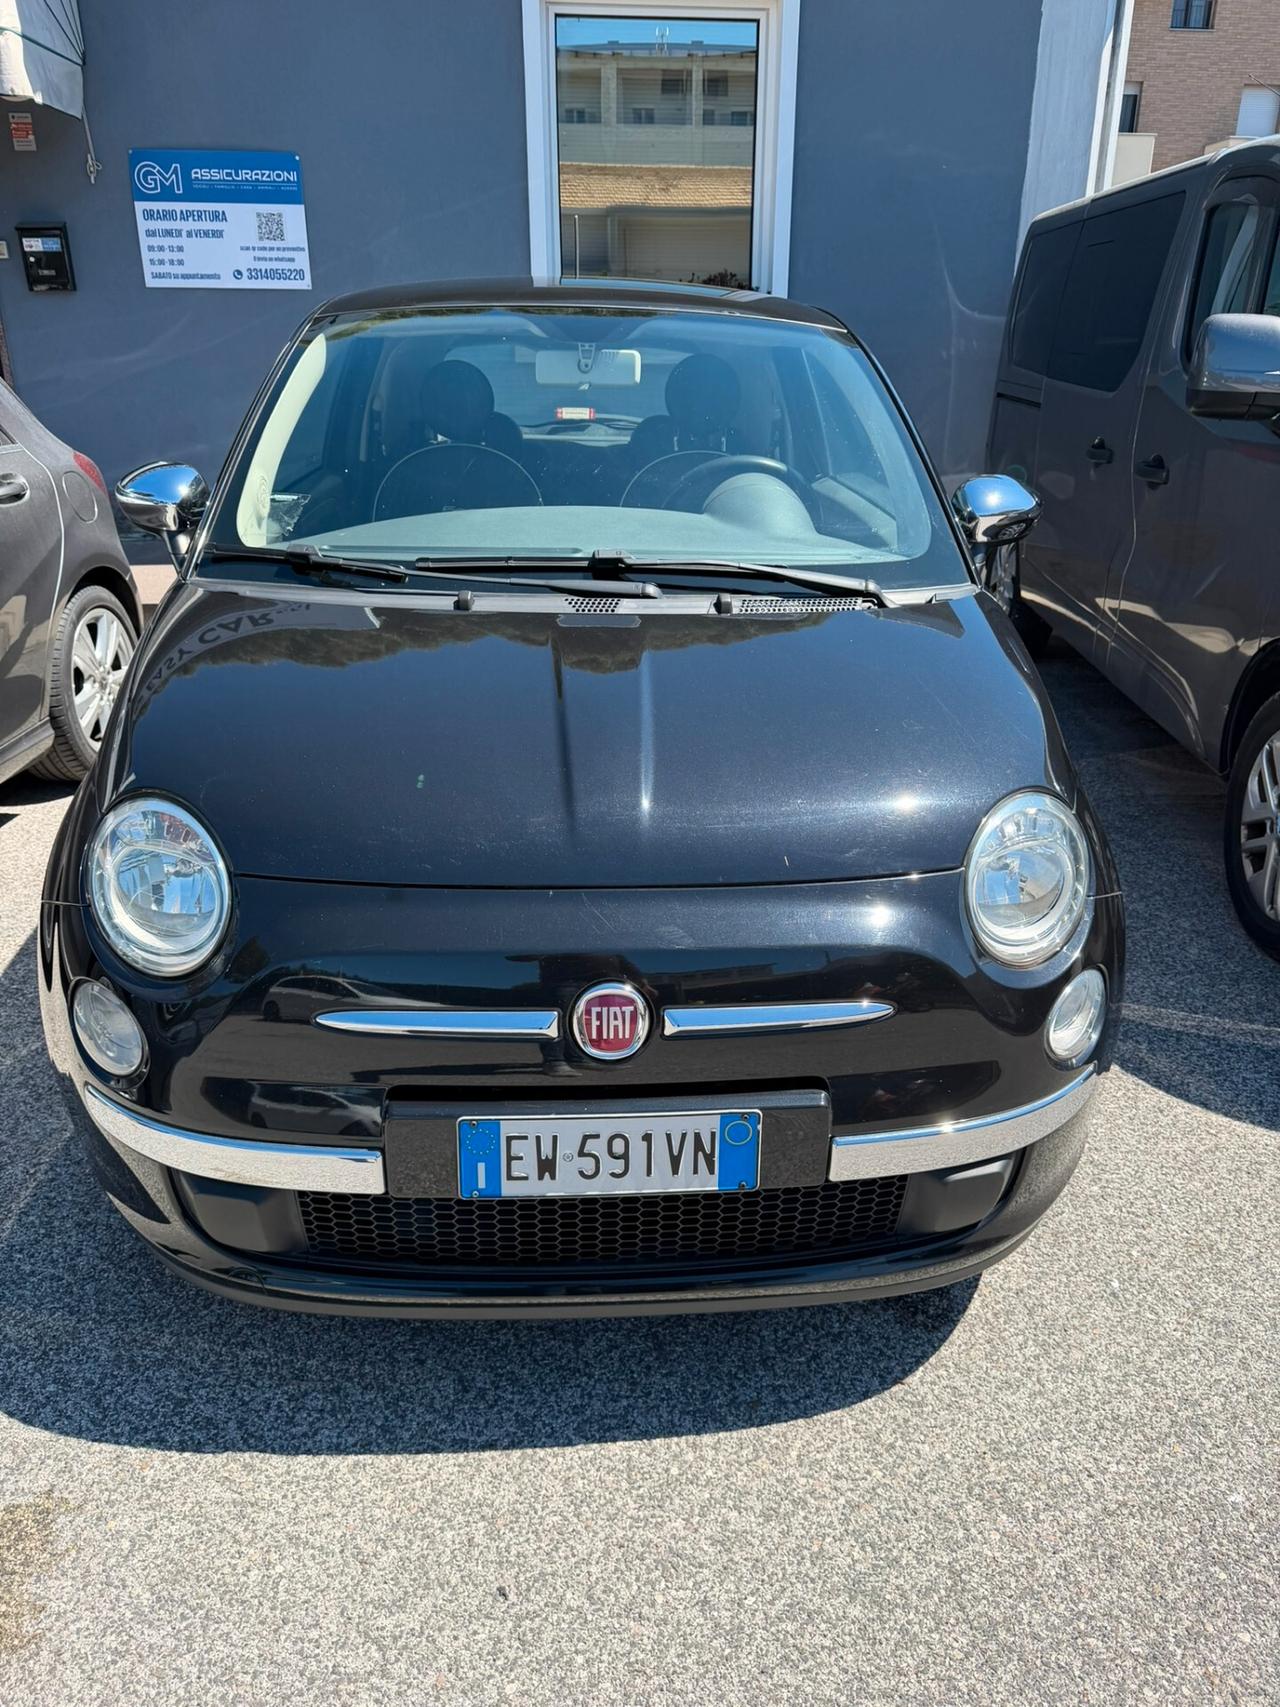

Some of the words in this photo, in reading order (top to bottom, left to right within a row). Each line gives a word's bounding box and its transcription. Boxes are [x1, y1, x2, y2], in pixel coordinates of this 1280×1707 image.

[134, 161, 183, 194] GM
[191, 168, 297, 182] ASSICURAZIONI
[142, 208, 178, 222] ORARIO
[179, 209, 228, 223] APERTURA
[145, 227, 157, 238] dal
[186, 229, 193, 239] al
[151, 271, 172, 280] SABATO
[180, 272, 222, 281] appuntamento
[246, 267, 306, 281] 3314055220
[591, 1006, 635, 1040] FIAT
